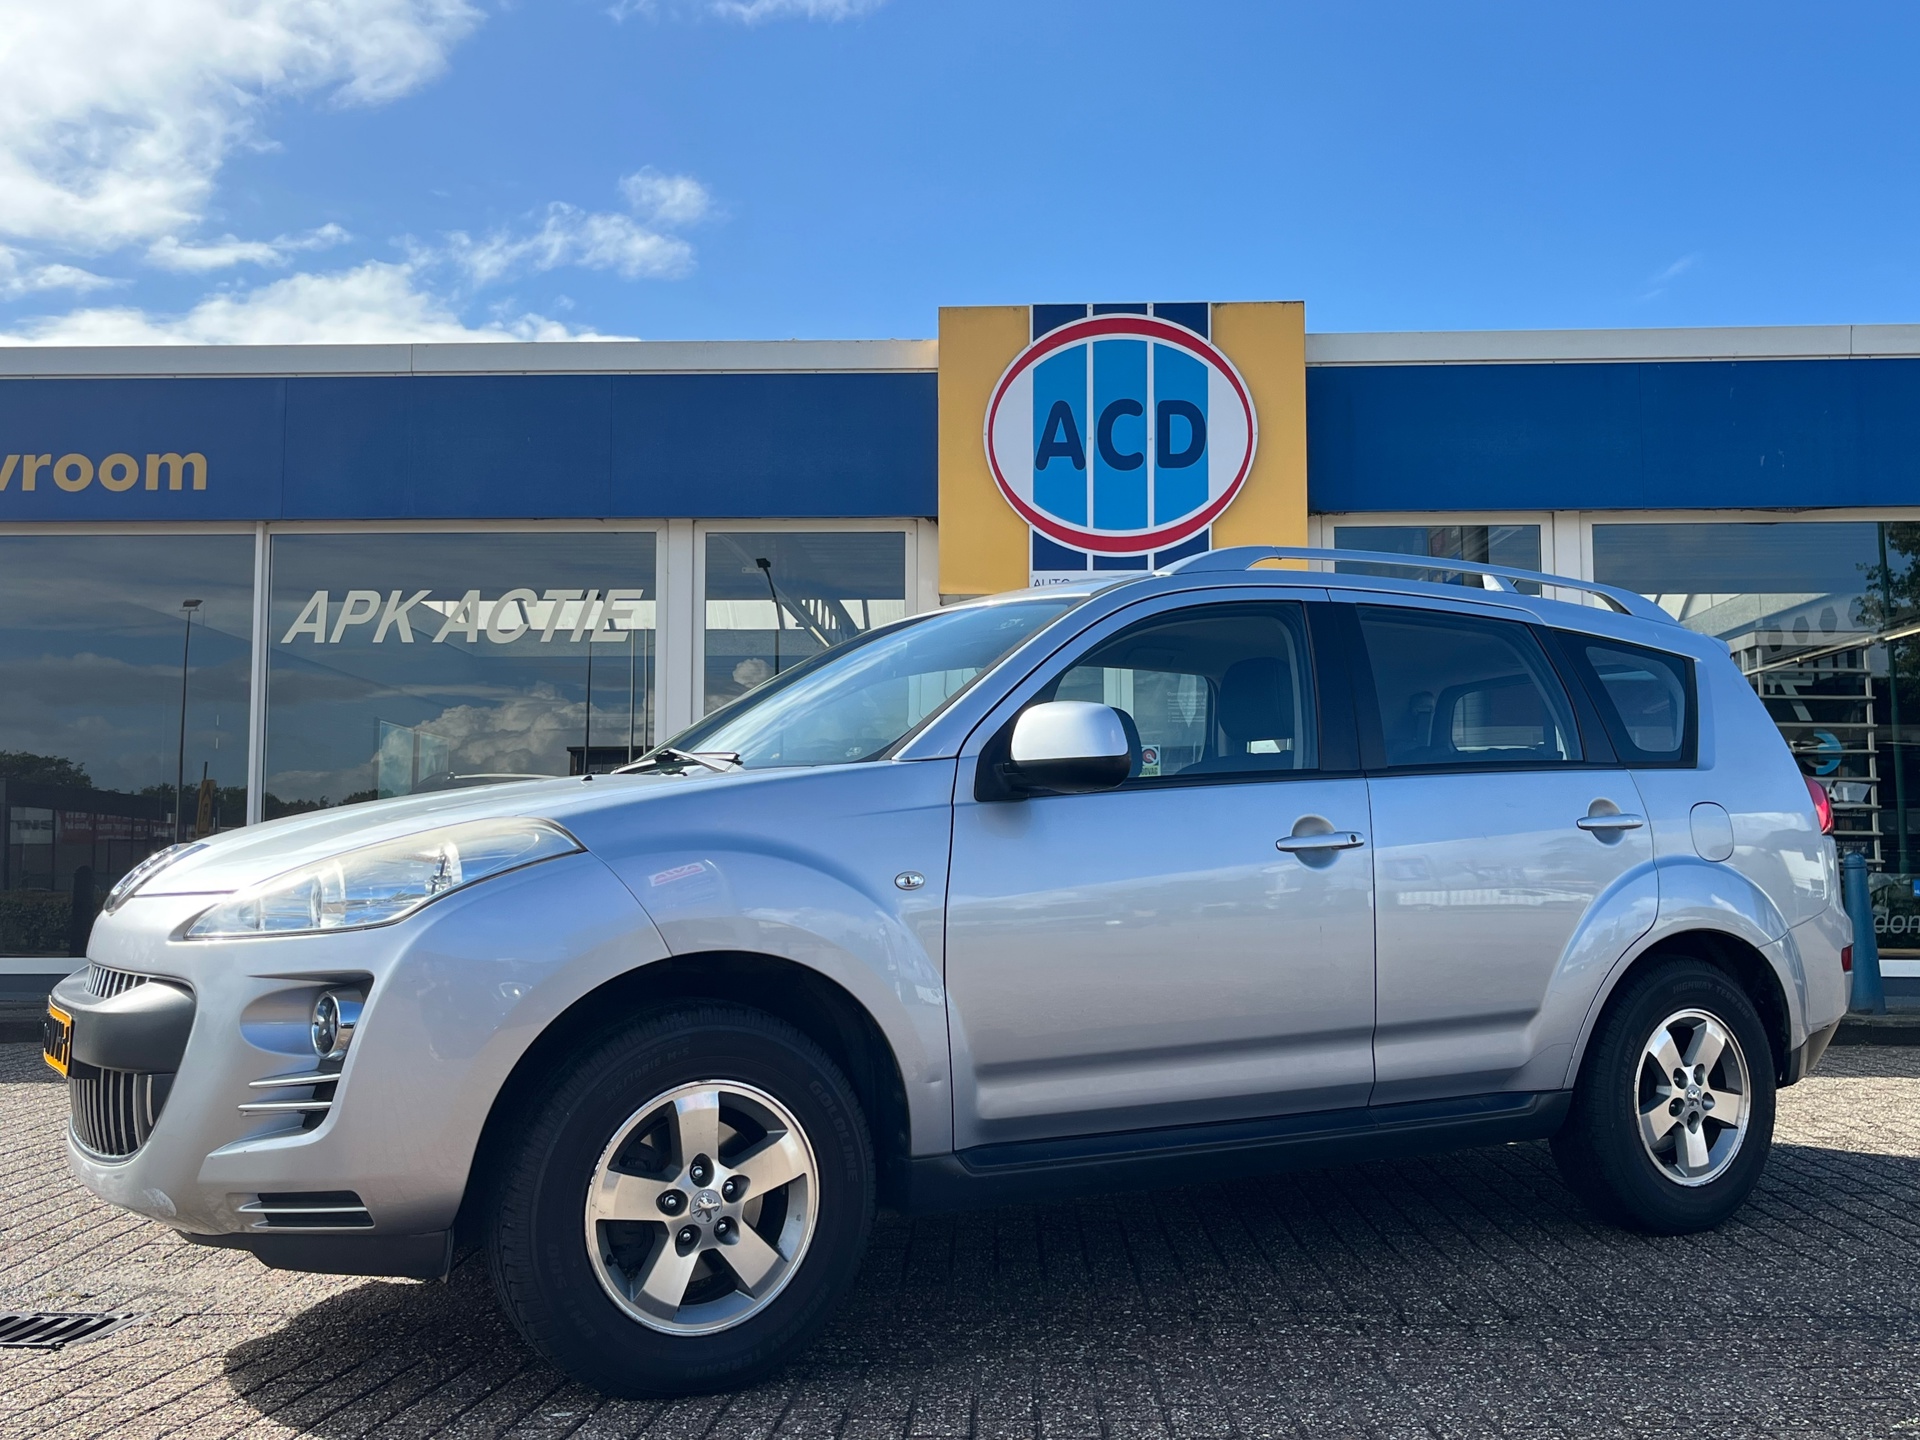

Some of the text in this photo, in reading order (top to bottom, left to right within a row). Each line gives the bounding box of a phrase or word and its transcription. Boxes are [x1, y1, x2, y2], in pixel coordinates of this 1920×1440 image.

[1035, 398, 1207, 471] ACD
[280, 588, 644, 644] APK ACTIE
[1672, 981, 1751, 1019] HIGHWAY TERRAIN
[808, 1080, 859, 1183] GOLDLINE
